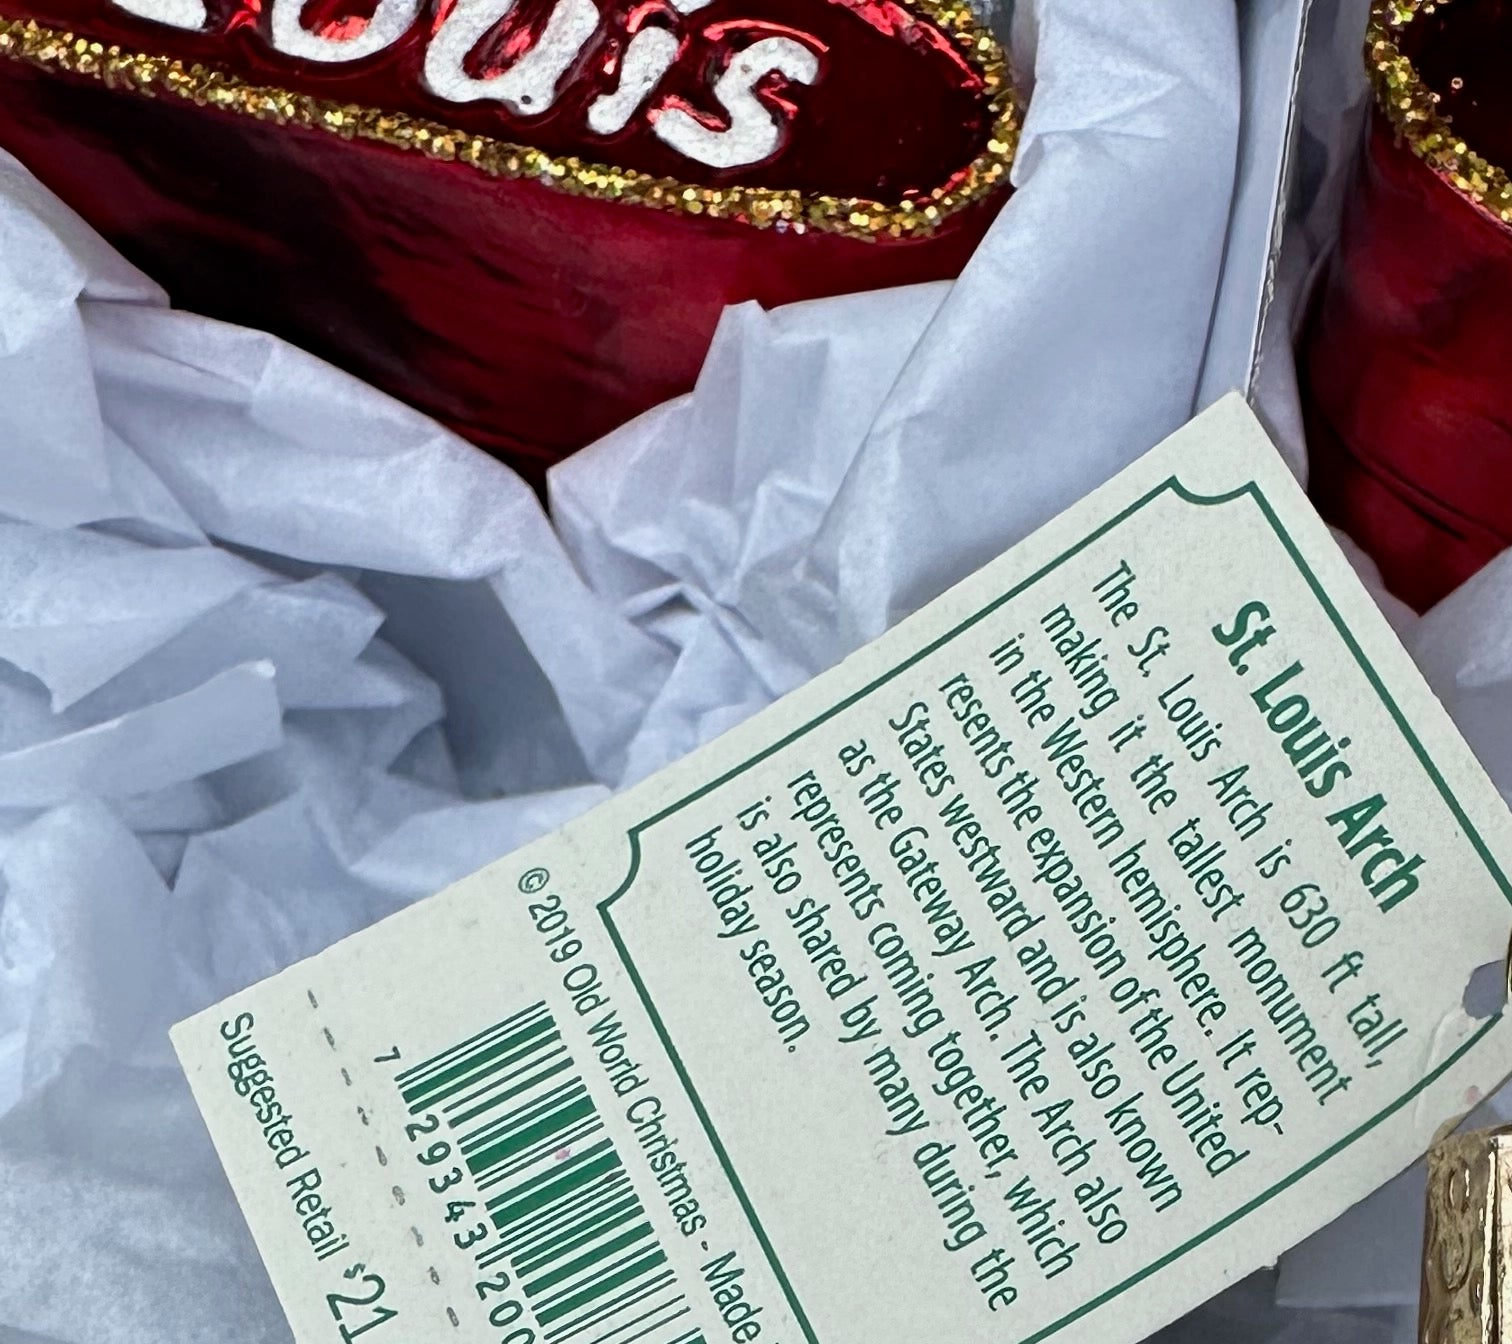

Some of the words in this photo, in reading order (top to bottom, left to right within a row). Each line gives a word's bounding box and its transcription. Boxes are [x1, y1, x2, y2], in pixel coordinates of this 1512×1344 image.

[987, 631, 1025, 676] in
[1009, 668, 1056, 730] the
[886, 700, 956, 798] States
[937, 671, 1016, 779] resents
[1209, 599, 1277, 677] St.
[1248, 658, 1353, 799] Louis
[1323, 791, 1427, 914] Arch
[734, 794, 772, 832] is
[995, 769, 1043, 832] the
[1039, 715, 1125, 850] Western
[1090, 557, 1139, 628] The
[1125, 624, 1171, 678] St.
[1156, 672, 1224, 763] Louis
[1205, 763, 1274, 842] Arch
[1253, 837, 1292, 879] is
[1278, 882, 1341, 949] 630
[1318, 949, 1365, 995] ft
[1344, 992, 1409, 1069] tall,
[751, 831, 802, 895] also
[937, 791, 1046, 943] westward
[1038, 601, 1120, 720] making
[1106, 713, 1147, 754] it
[1129, 752, 1178, 816] the
[1165, 816, 1246, 923] tallest
[1226, 925, 1353, 1107] monument
[526, 893, 583, 964] 2019
[683, 823, 760, 939] holiday
[738, 938, 811, 1054] season.
[784, 894, 869, 1001] shared
[1025, 826, 1127, 980] expansion
[1107, 838, 1227, 1038] hemisphere.
[561, 962, 611, 1017] Old
[836, 737, 876, 777] as
[857, 770, 904, 831] the
[888, 824, 976, 958] Gateway
[953, 954, 1019, 1042] Arch.
[999, 1027, 1050, 1102] The
[1029, 1097, 1098, 1177] Arch
[1073, 1174, 1128, 1245] also
[836, 993, 883, 1044] by
[1015, 937, 1081, 1006] and
[1049, 993, 1088, 1034] is
[1108, 976, 1161, 1014] of
[585, 1008, 650, 1098] World
[785, 768, 885, 921] represents
[866, 921, 946, 1039] coming
[926, 1030, 1019, 1180] together,
[1002, 1173, 1081, 1280] which
[1066, 1031, 1121, 1100] also
[1127, 1006, 1178, 1071] the
[1214, 1027, 1257, 1071] It
[218, 1011, 311, 1170] Suggested
[284, 1166, 350, 1262] Retail
[862, 1044, 930, 1136] many
[1160, 1058, 1251, 1179] United
[1233, 1065, 1284, 1136] rep-
[372, 1044, 401, 1063] 7
[403, 1112, 489, 1251] 29343
[624, 1094, 707, 1238] Christmas
[1102, 1090, 1183, 1213] known
[911, 1141, 988, 1252] during
[698, 1249, 764, 1344] Made
[969, 1247, 1018, 1312] the
